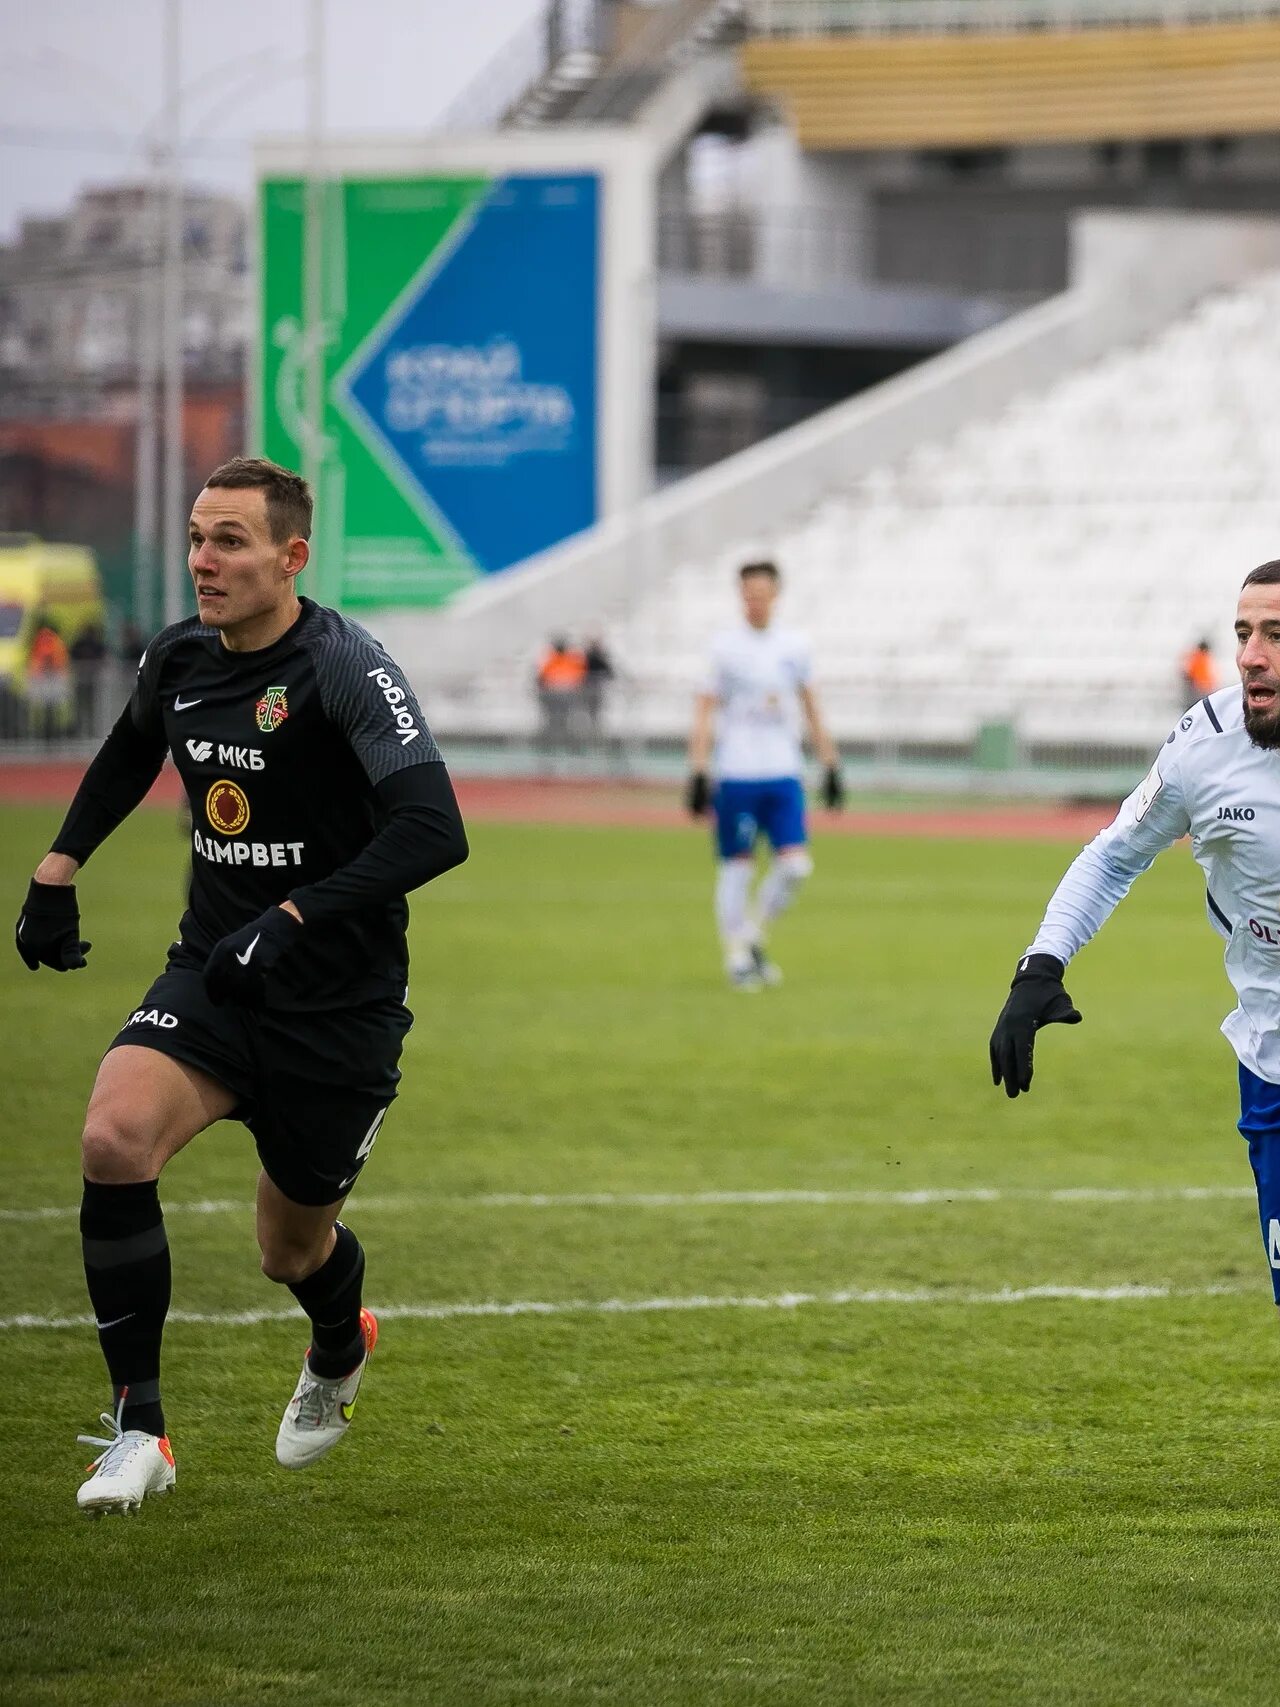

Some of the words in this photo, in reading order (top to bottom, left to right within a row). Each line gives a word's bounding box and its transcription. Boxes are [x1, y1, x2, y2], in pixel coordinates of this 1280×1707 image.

[367, 667, 420, 746] Vorgol
[218, 743, 266, 771] МКБ
[1216, 806, 1255, 821] JAKO
